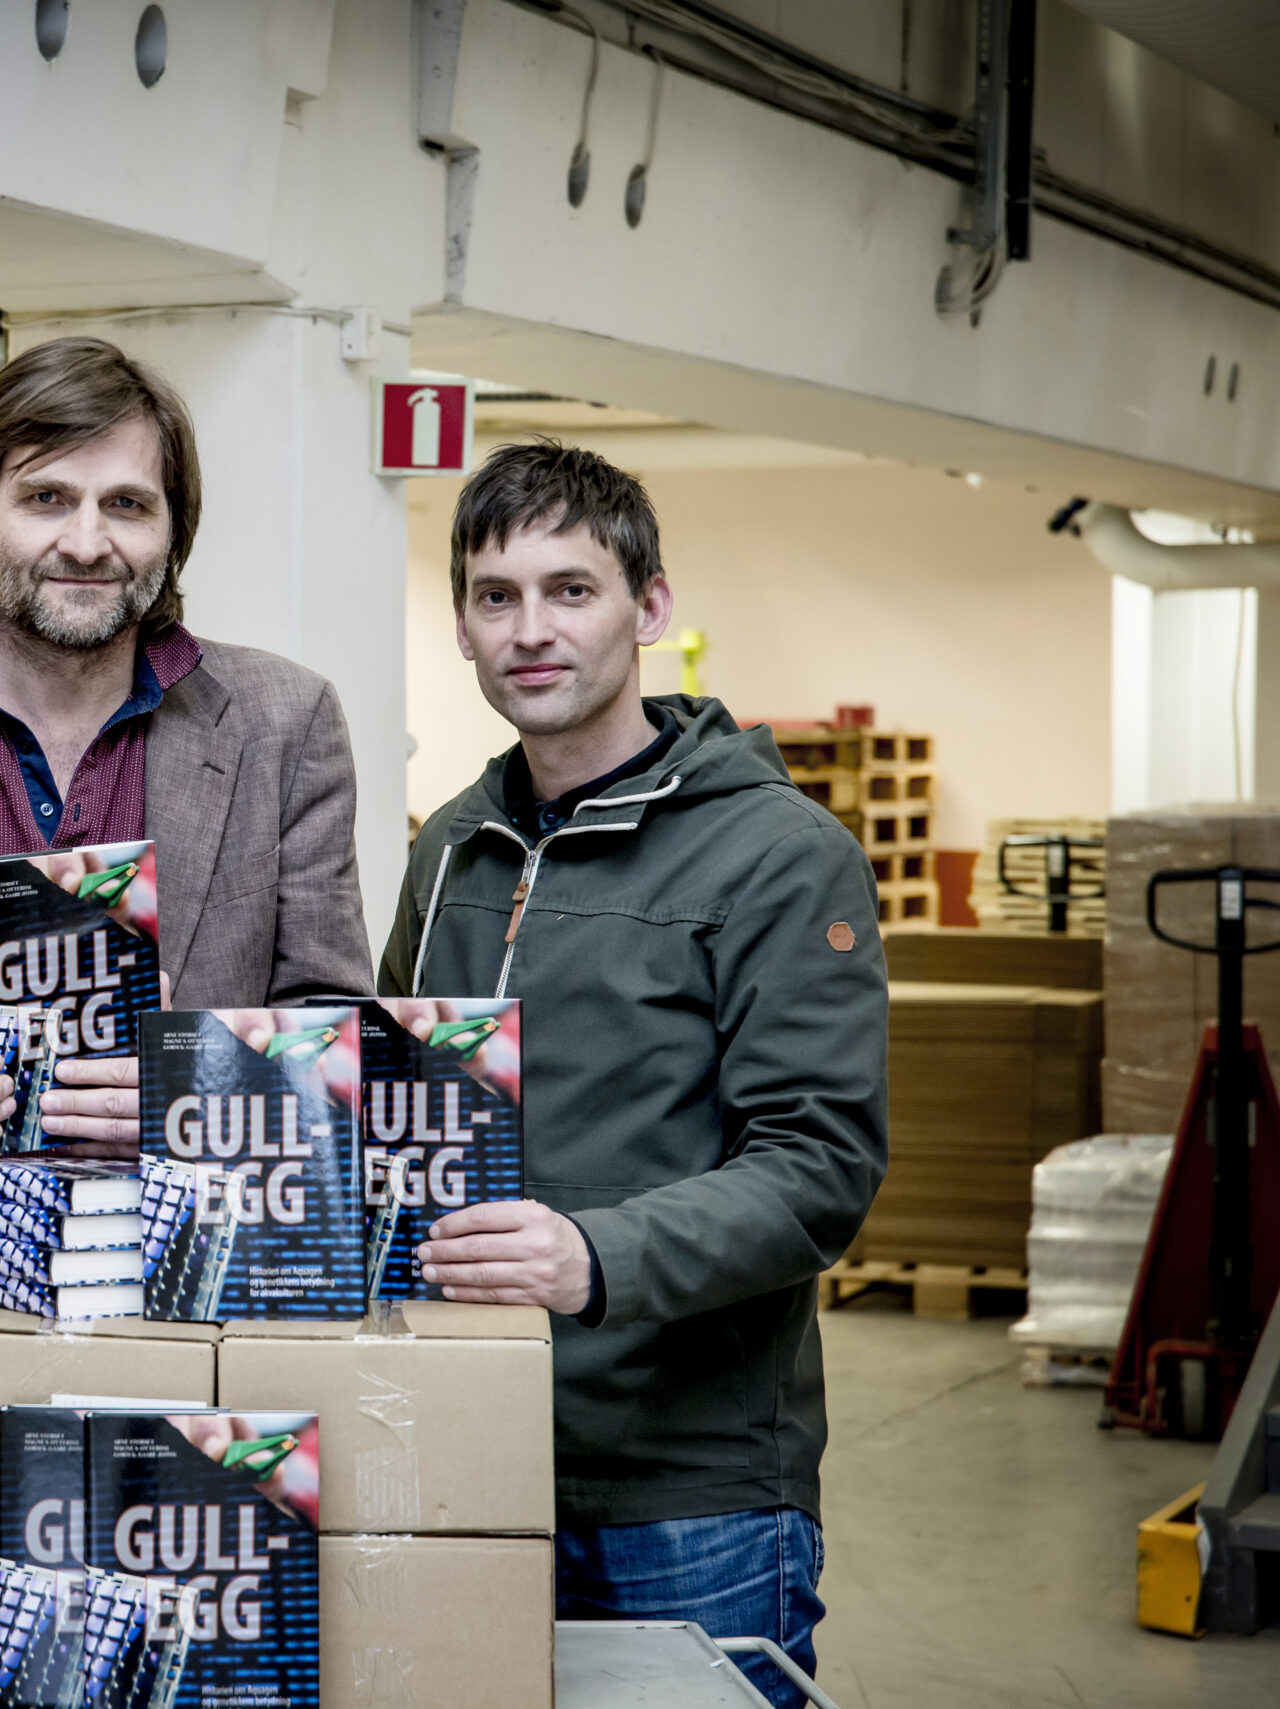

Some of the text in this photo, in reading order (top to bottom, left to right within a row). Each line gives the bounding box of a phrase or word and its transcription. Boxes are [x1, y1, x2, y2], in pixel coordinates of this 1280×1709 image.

[17, 990, 116, 1062] EGG
[165, 1094, 331, 1158] GULL-
[363, 1081, 492, 1142] ULL-
[194, 1161, 305, 1224] EGG
[364, 1146, 466, 1207] EGG
[249, 1266, 279, 1276] Historien
[280, 1268, 291, 1276] om
[249, 1278, 259, 1288] og
[301, 1277, 335, 1288] betydning
[249, 1288, 259, 1297] for
[115, 1504, 289, 1571] GULL-
[145, 1575, 261, 1641] EGG
